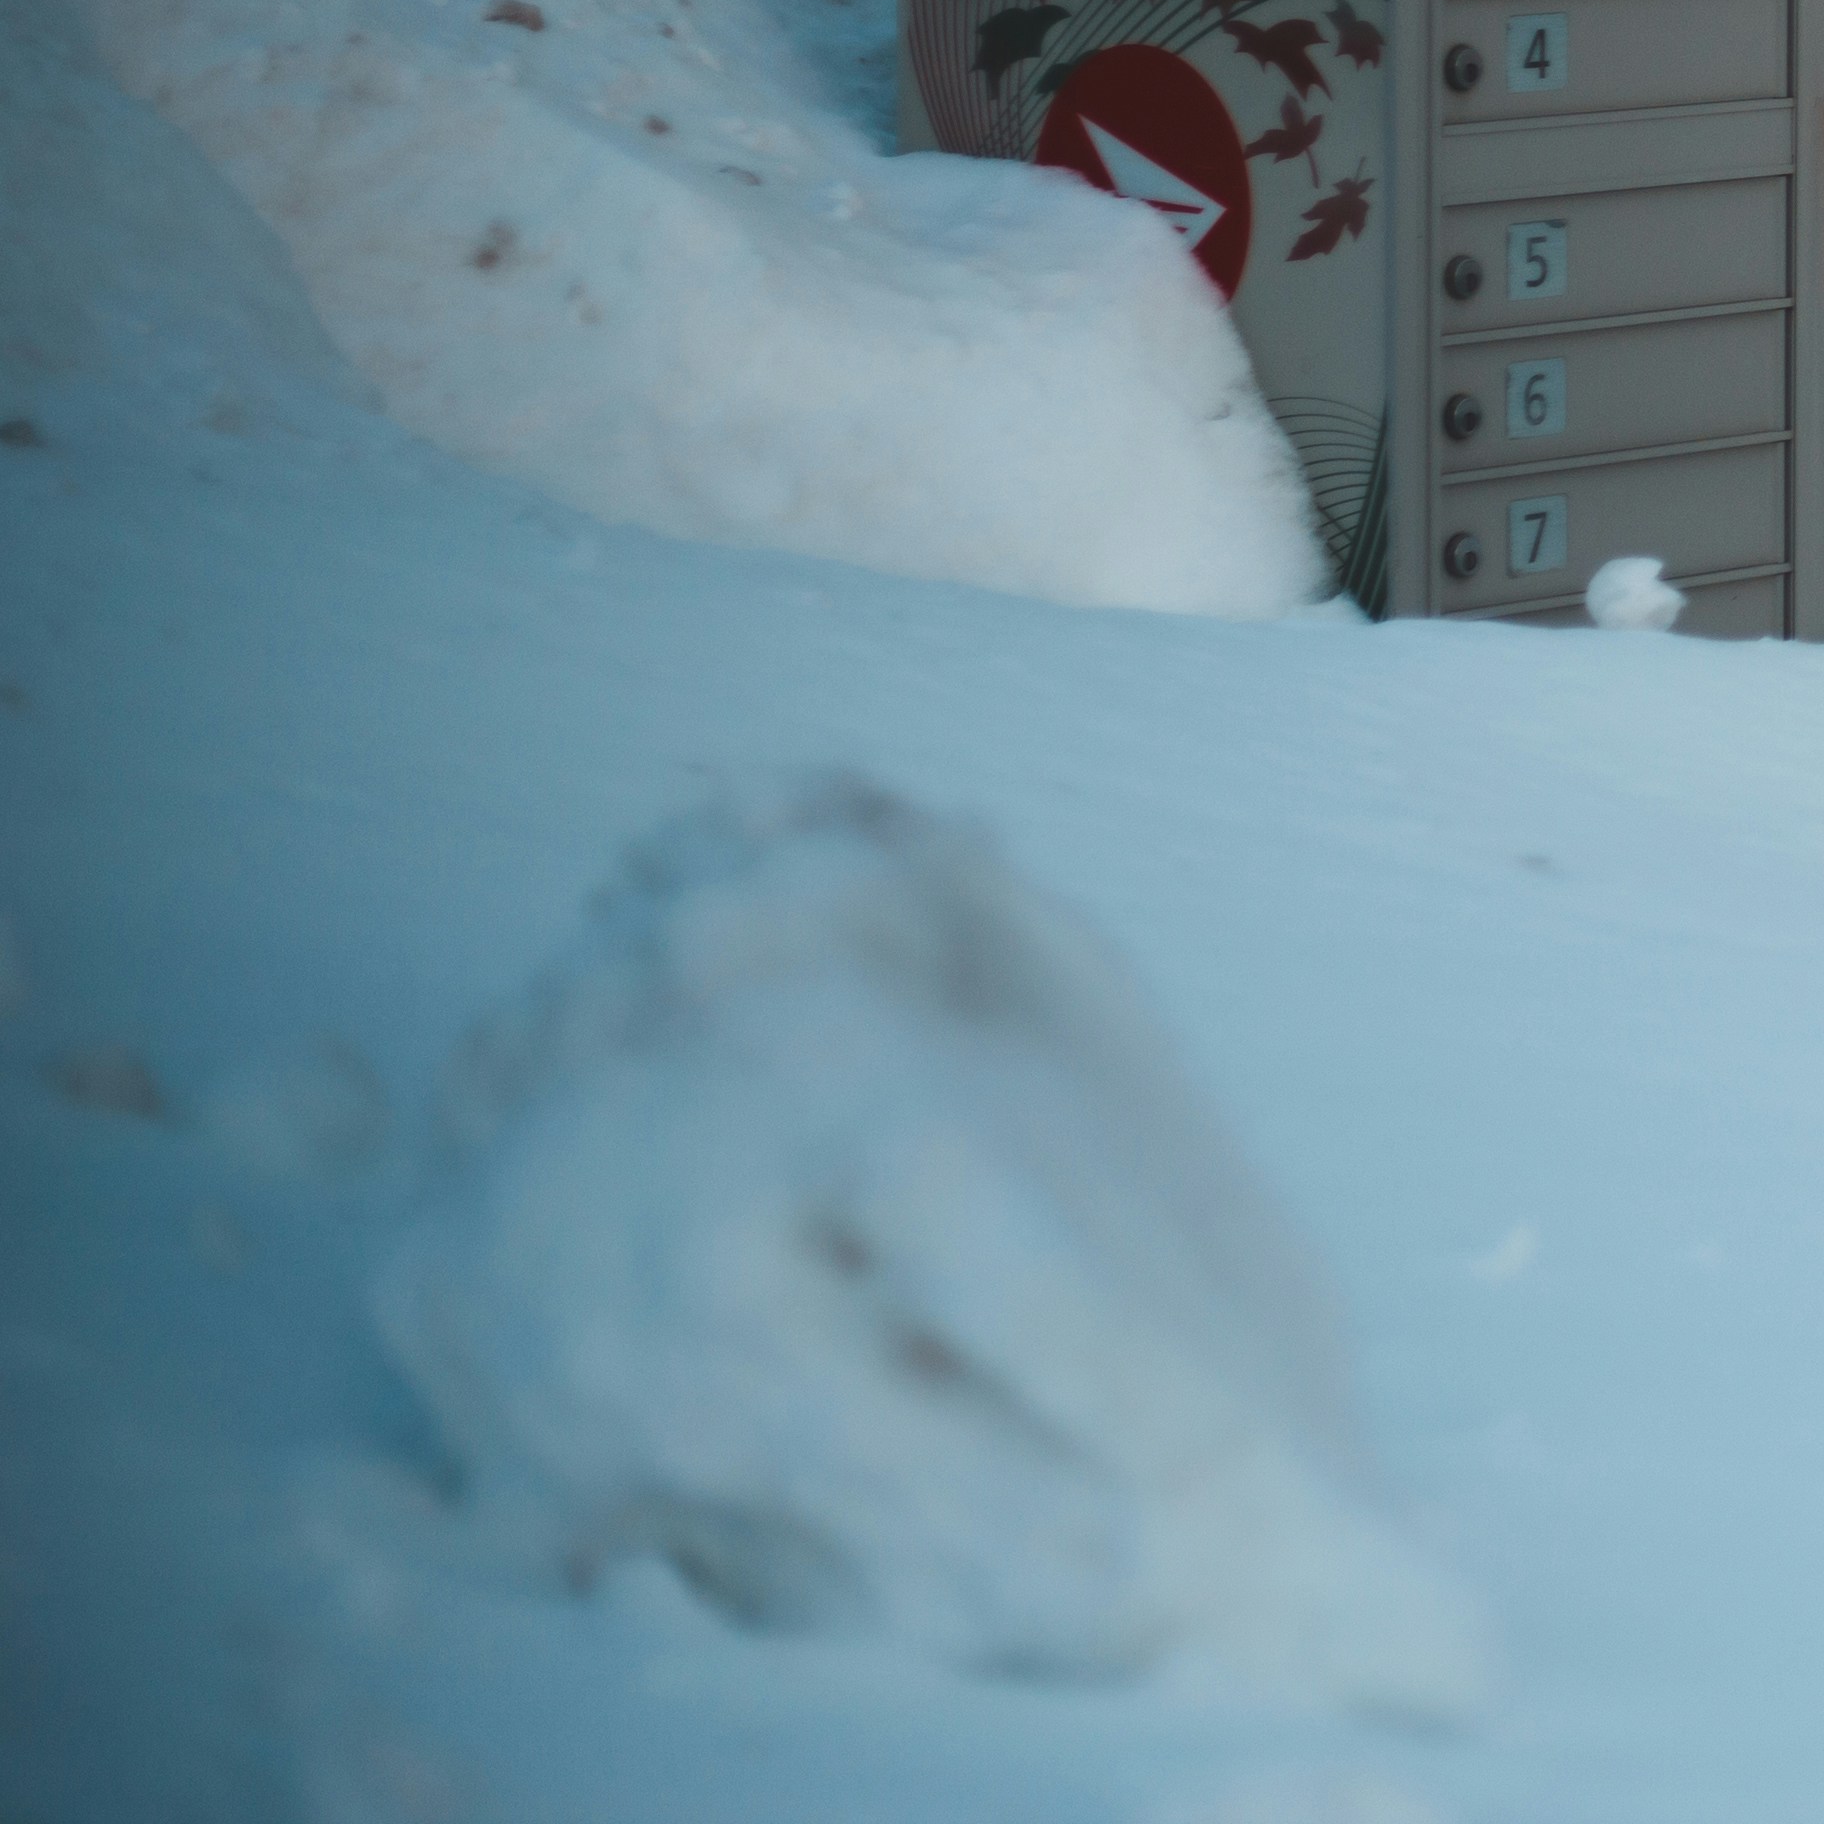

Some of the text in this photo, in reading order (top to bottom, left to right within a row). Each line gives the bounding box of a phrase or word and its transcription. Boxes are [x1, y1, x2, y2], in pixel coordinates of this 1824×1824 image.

[1524, 28, 1550, 78] 4
[1525, 237, 1548, 286] 5
[1525, 375, 1547, 424] 6
[1525, 513, 1548, 564] 7
